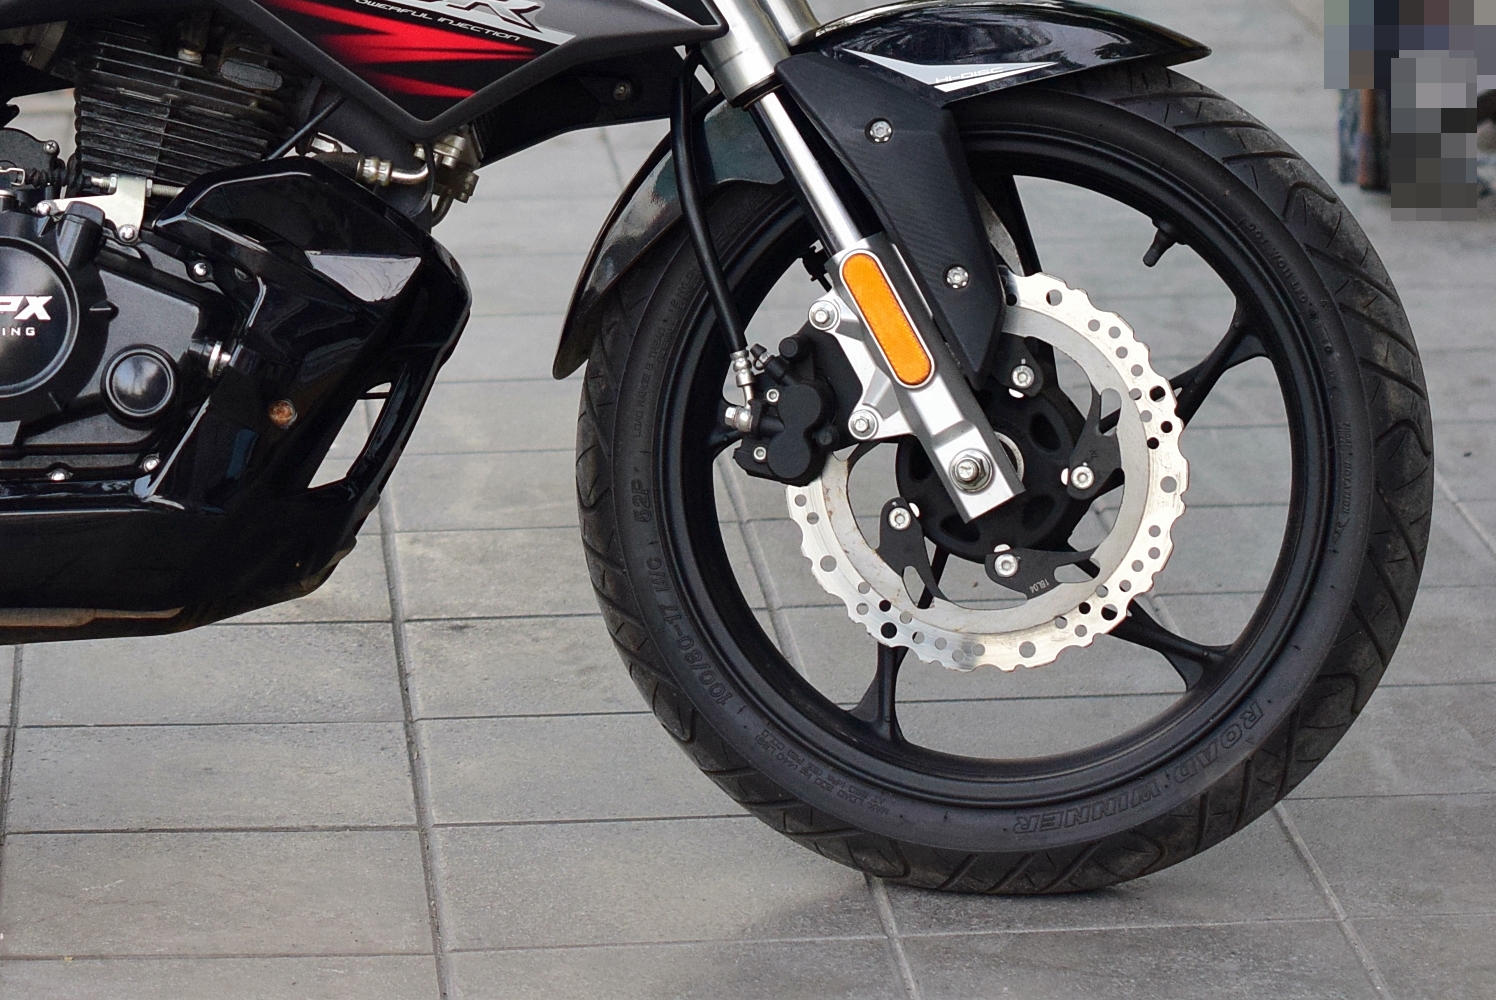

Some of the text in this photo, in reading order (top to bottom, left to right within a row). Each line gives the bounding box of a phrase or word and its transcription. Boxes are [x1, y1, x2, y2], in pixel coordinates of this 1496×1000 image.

[437, 16, 521, 43] INJECTION
[935, 67, 1002, 83] HI-DISC
[631, 478, 651, 522] 52P
[658, 602, 732, 705] 100/80-17
[1012, 701, 1264, 833] ROAD WINNER
